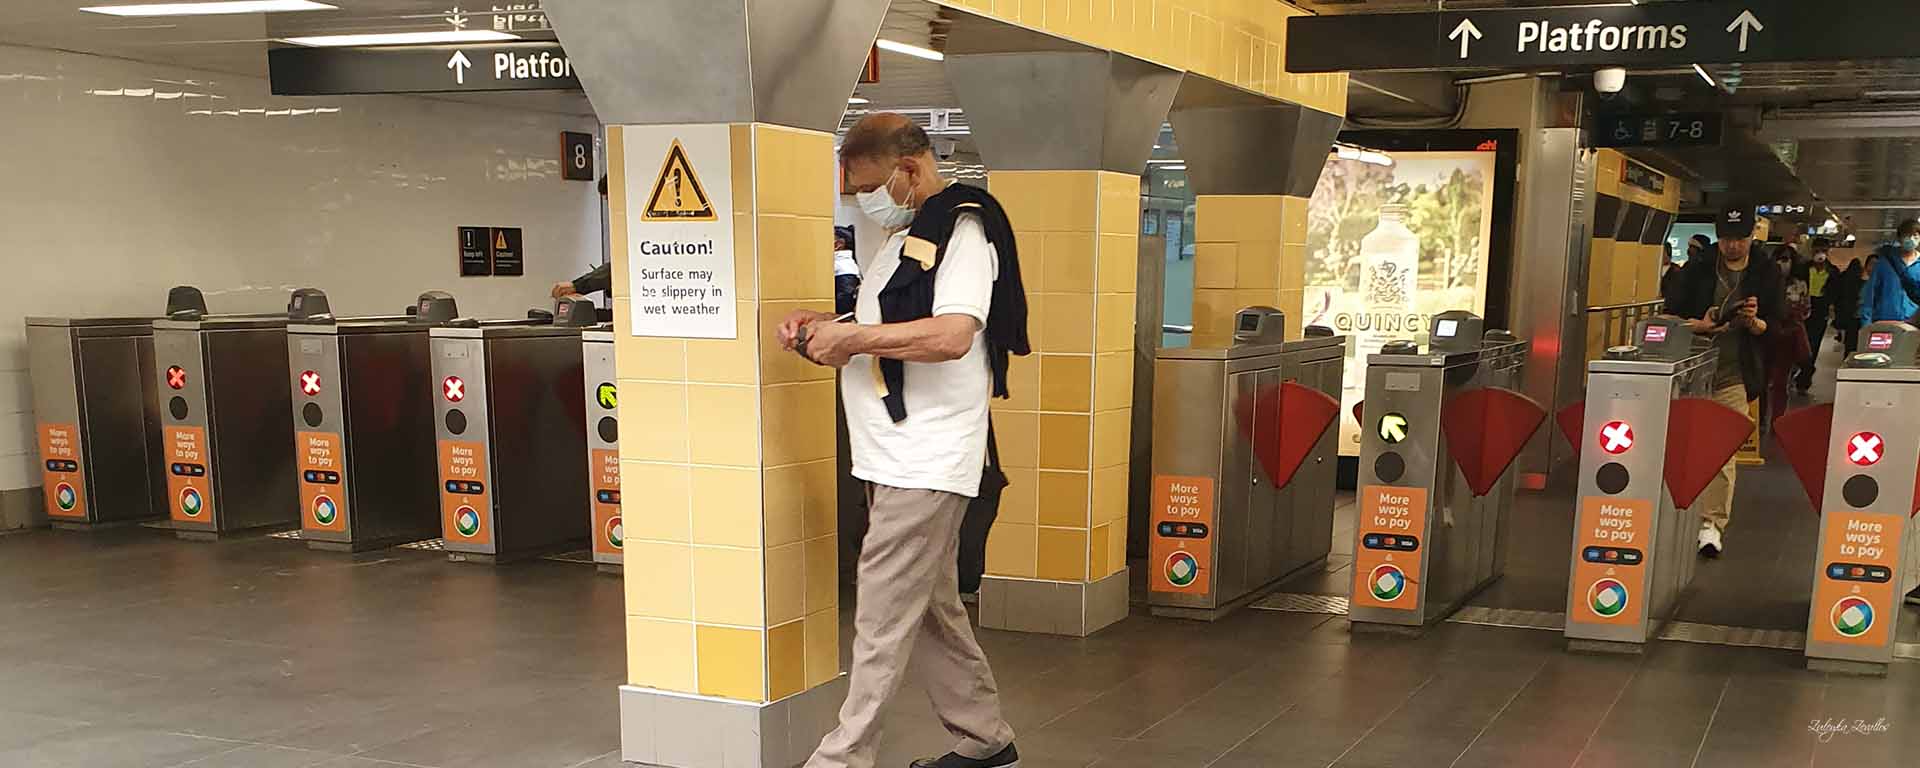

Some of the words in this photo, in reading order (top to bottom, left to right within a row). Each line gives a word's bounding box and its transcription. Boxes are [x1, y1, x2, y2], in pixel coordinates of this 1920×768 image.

[1517, 19, 1688, 53] Platforms
[1668, 120, 1704, 139] 7-8
[575, 144, 586, 169] 8
[640, 239, 713, 255] Caution!
[641, 267, 683, 280] Surface
[688, 270, 713, 282] may
[642, 285, 656, 297] be
[661, 285, 706, 300] slippery
[711, 285, 723, 297] in
[644, 303, 666, 315] wet
[671, 302, 720, 315] weather
[1334, 312, 1433, 332] QUINCY
[309, 438, 330, 447] More
[310, 448, 330, 457] ways
[452, 446, 473, 455] More
[308, 456, 317, 464] to
[318, 457, 333, 467] pay
[452, 457, 474, 466] ways
[450, 466, 460, 474] to
[461, 467, 477, 477] pay
[603, 475, 613, 483] to
[1170, 482, 1199, 494] More
[1170, 495, 1198, 506] ways
[1379, 493, 1410, 505] More
[1166, 505, 1178, 514] to
[1180, 507, 1200, 518] pay
[1378, 506, 1409, 518] ways
[1600, 504, 1633, 517] More
[1374, 516, 1387, 526] to
[1389, 518, 1411, 530] pay
[1600, 518, 1632, 530] ways
[1848, 519, 1882, 532] More
[1594, 528, 1608, 538] to
[1611, 530, 1634, 543] pay
[1846, 533, 1881, 546] ways
[1840, 544, 1855, 555] to
[1858, 546, 1884, 560] pay
